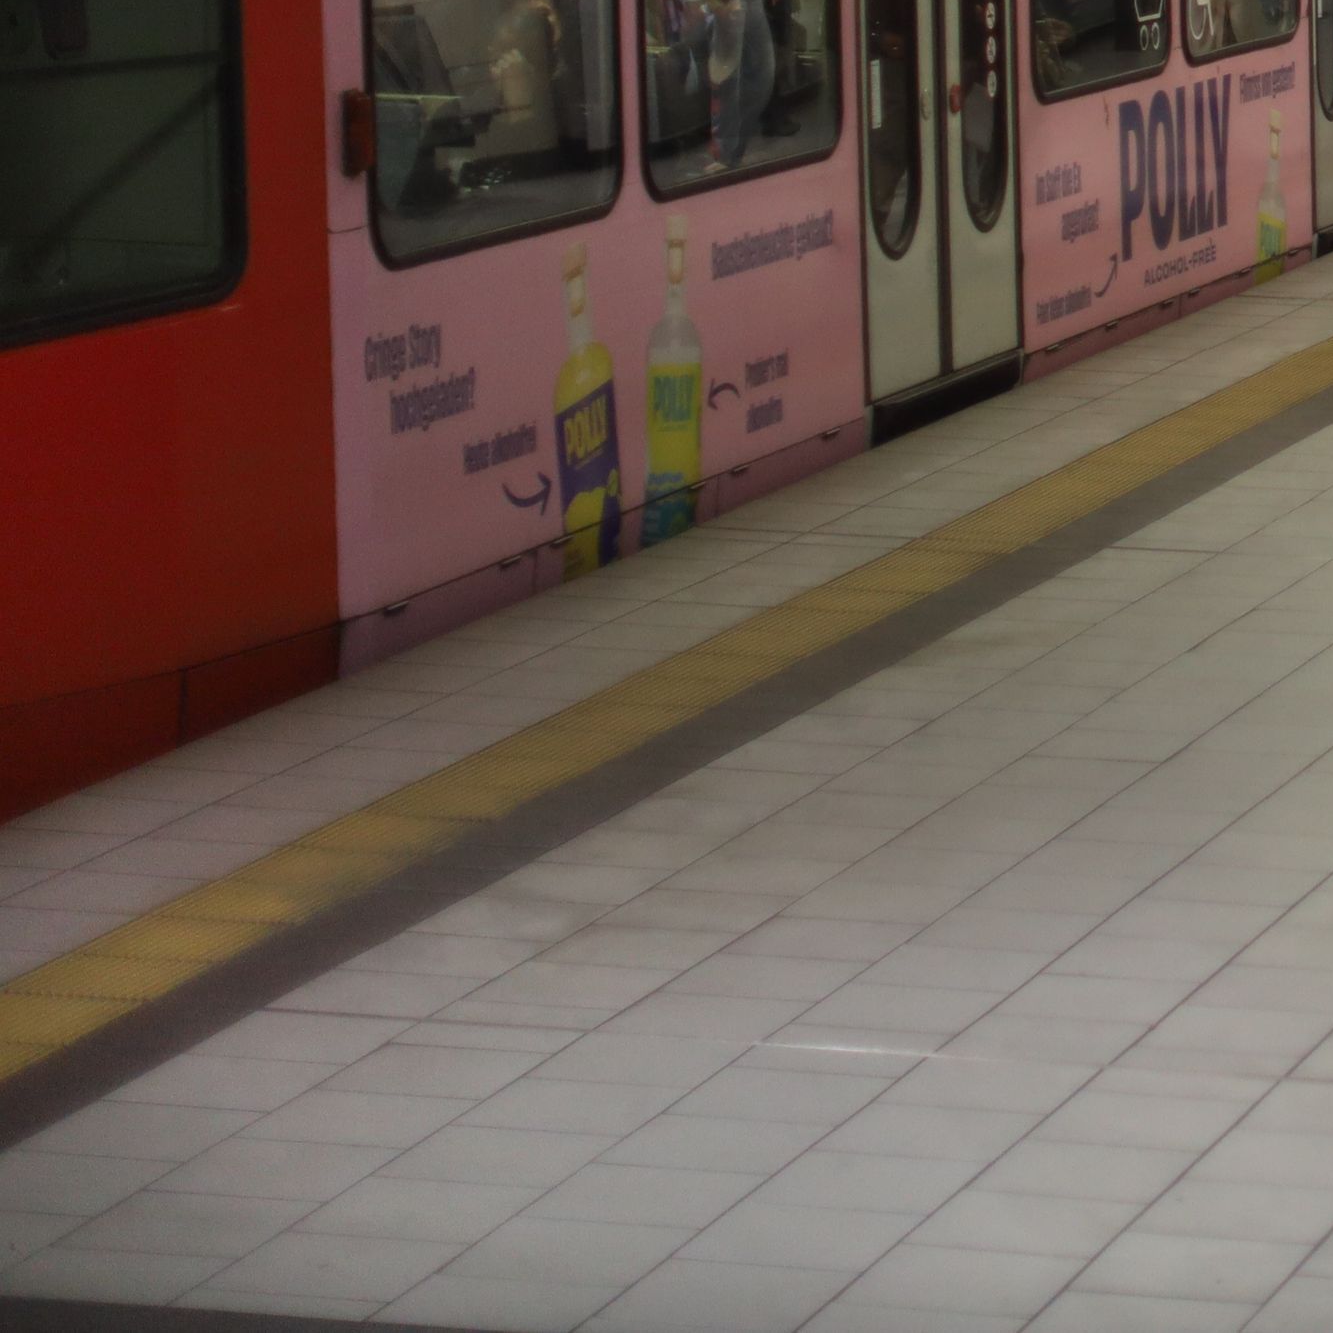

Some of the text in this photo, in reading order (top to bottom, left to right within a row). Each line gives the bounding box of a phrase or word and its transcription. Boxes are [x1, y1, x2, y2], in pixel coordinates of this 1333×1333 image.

[1119, 73, 1231, 262] POLLY
[1144, 247, 1217, 286] ALCOHOL-FREE
[408, 323, 441, 370] Story
[655, 375, 694, 421] POLLY
[564, 394, 607, 465] POLLY
